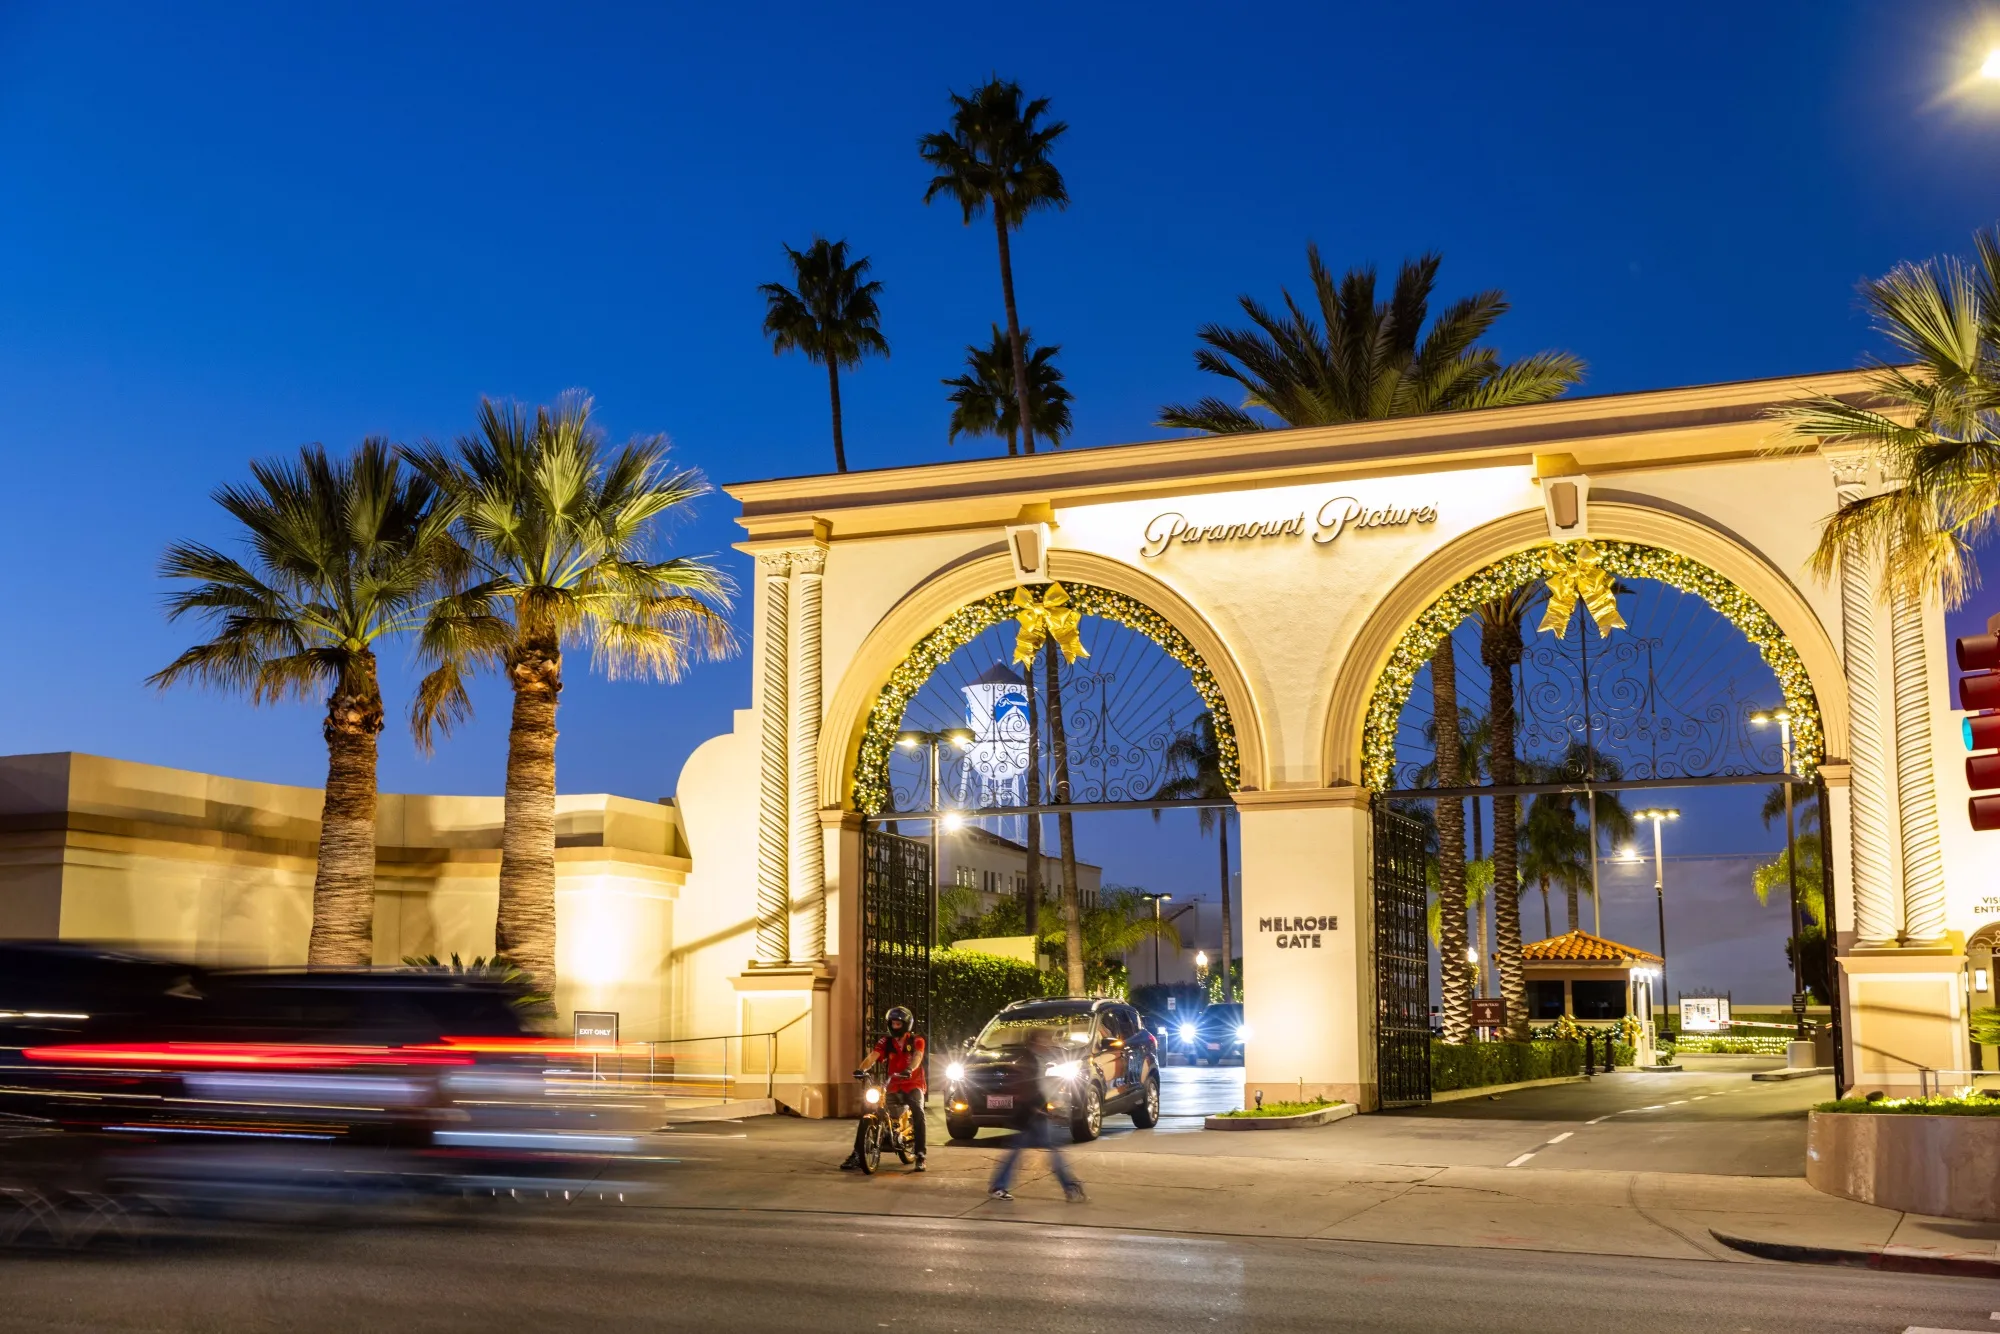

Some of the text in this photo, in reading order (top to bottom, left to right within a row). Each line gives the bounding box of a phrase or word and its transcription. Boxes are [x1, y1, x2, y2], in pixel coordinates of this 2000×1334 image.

[1140, 496, 1439, 558] Paramount Pictures
[1259, 916, 1338, 932] MELROSE
[1276, 934, 1321, 949] GATE
